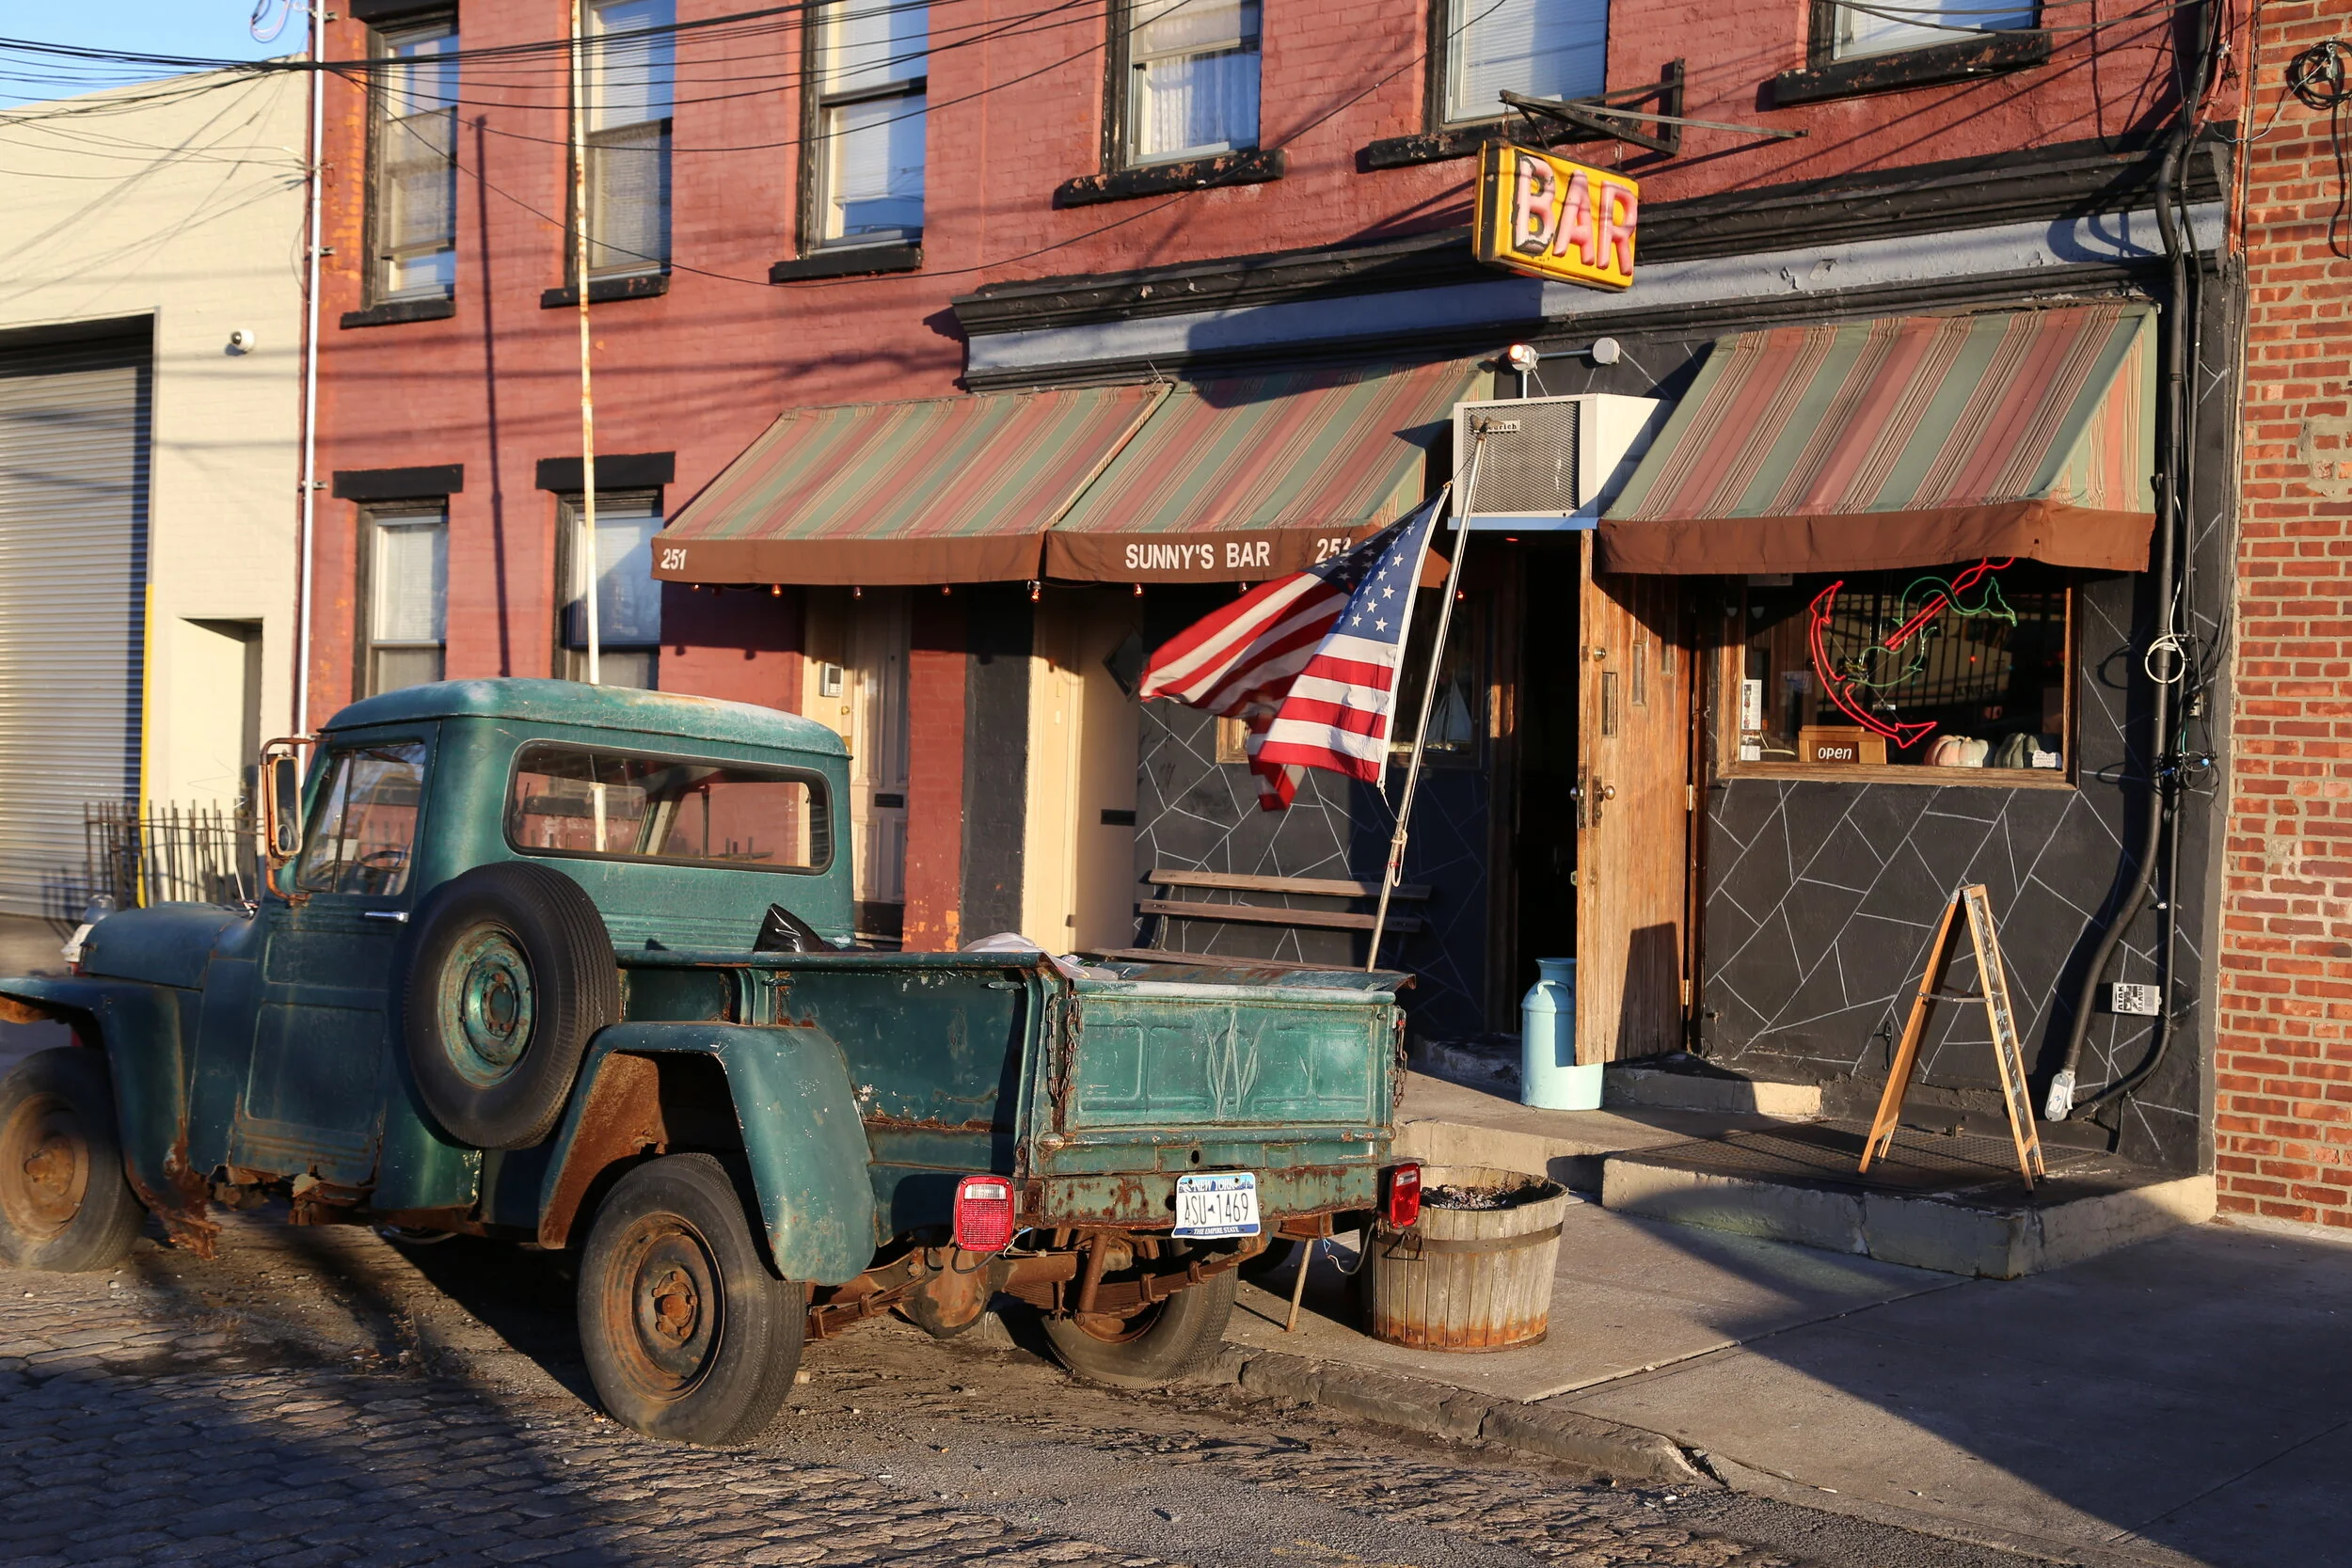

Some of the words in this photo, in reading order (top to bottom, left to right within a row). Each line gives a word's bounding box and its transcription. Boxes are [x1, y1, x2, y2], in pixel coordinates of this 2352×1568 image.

[1511, 150, 1638, 277] BAR
[660, 547, 687, 571] 251
[1125, 543, 1215, 570] SUNNY'S
[1226, 541, 1270, 568] BAR
[1193, 1179, 1213, 1192] NEW
[1213, 1178, 1235, 1191] YORK
[1204, 1227, 1223, 1235] EMPIRE
[1223, 1226, 1239, 1234] STATE
